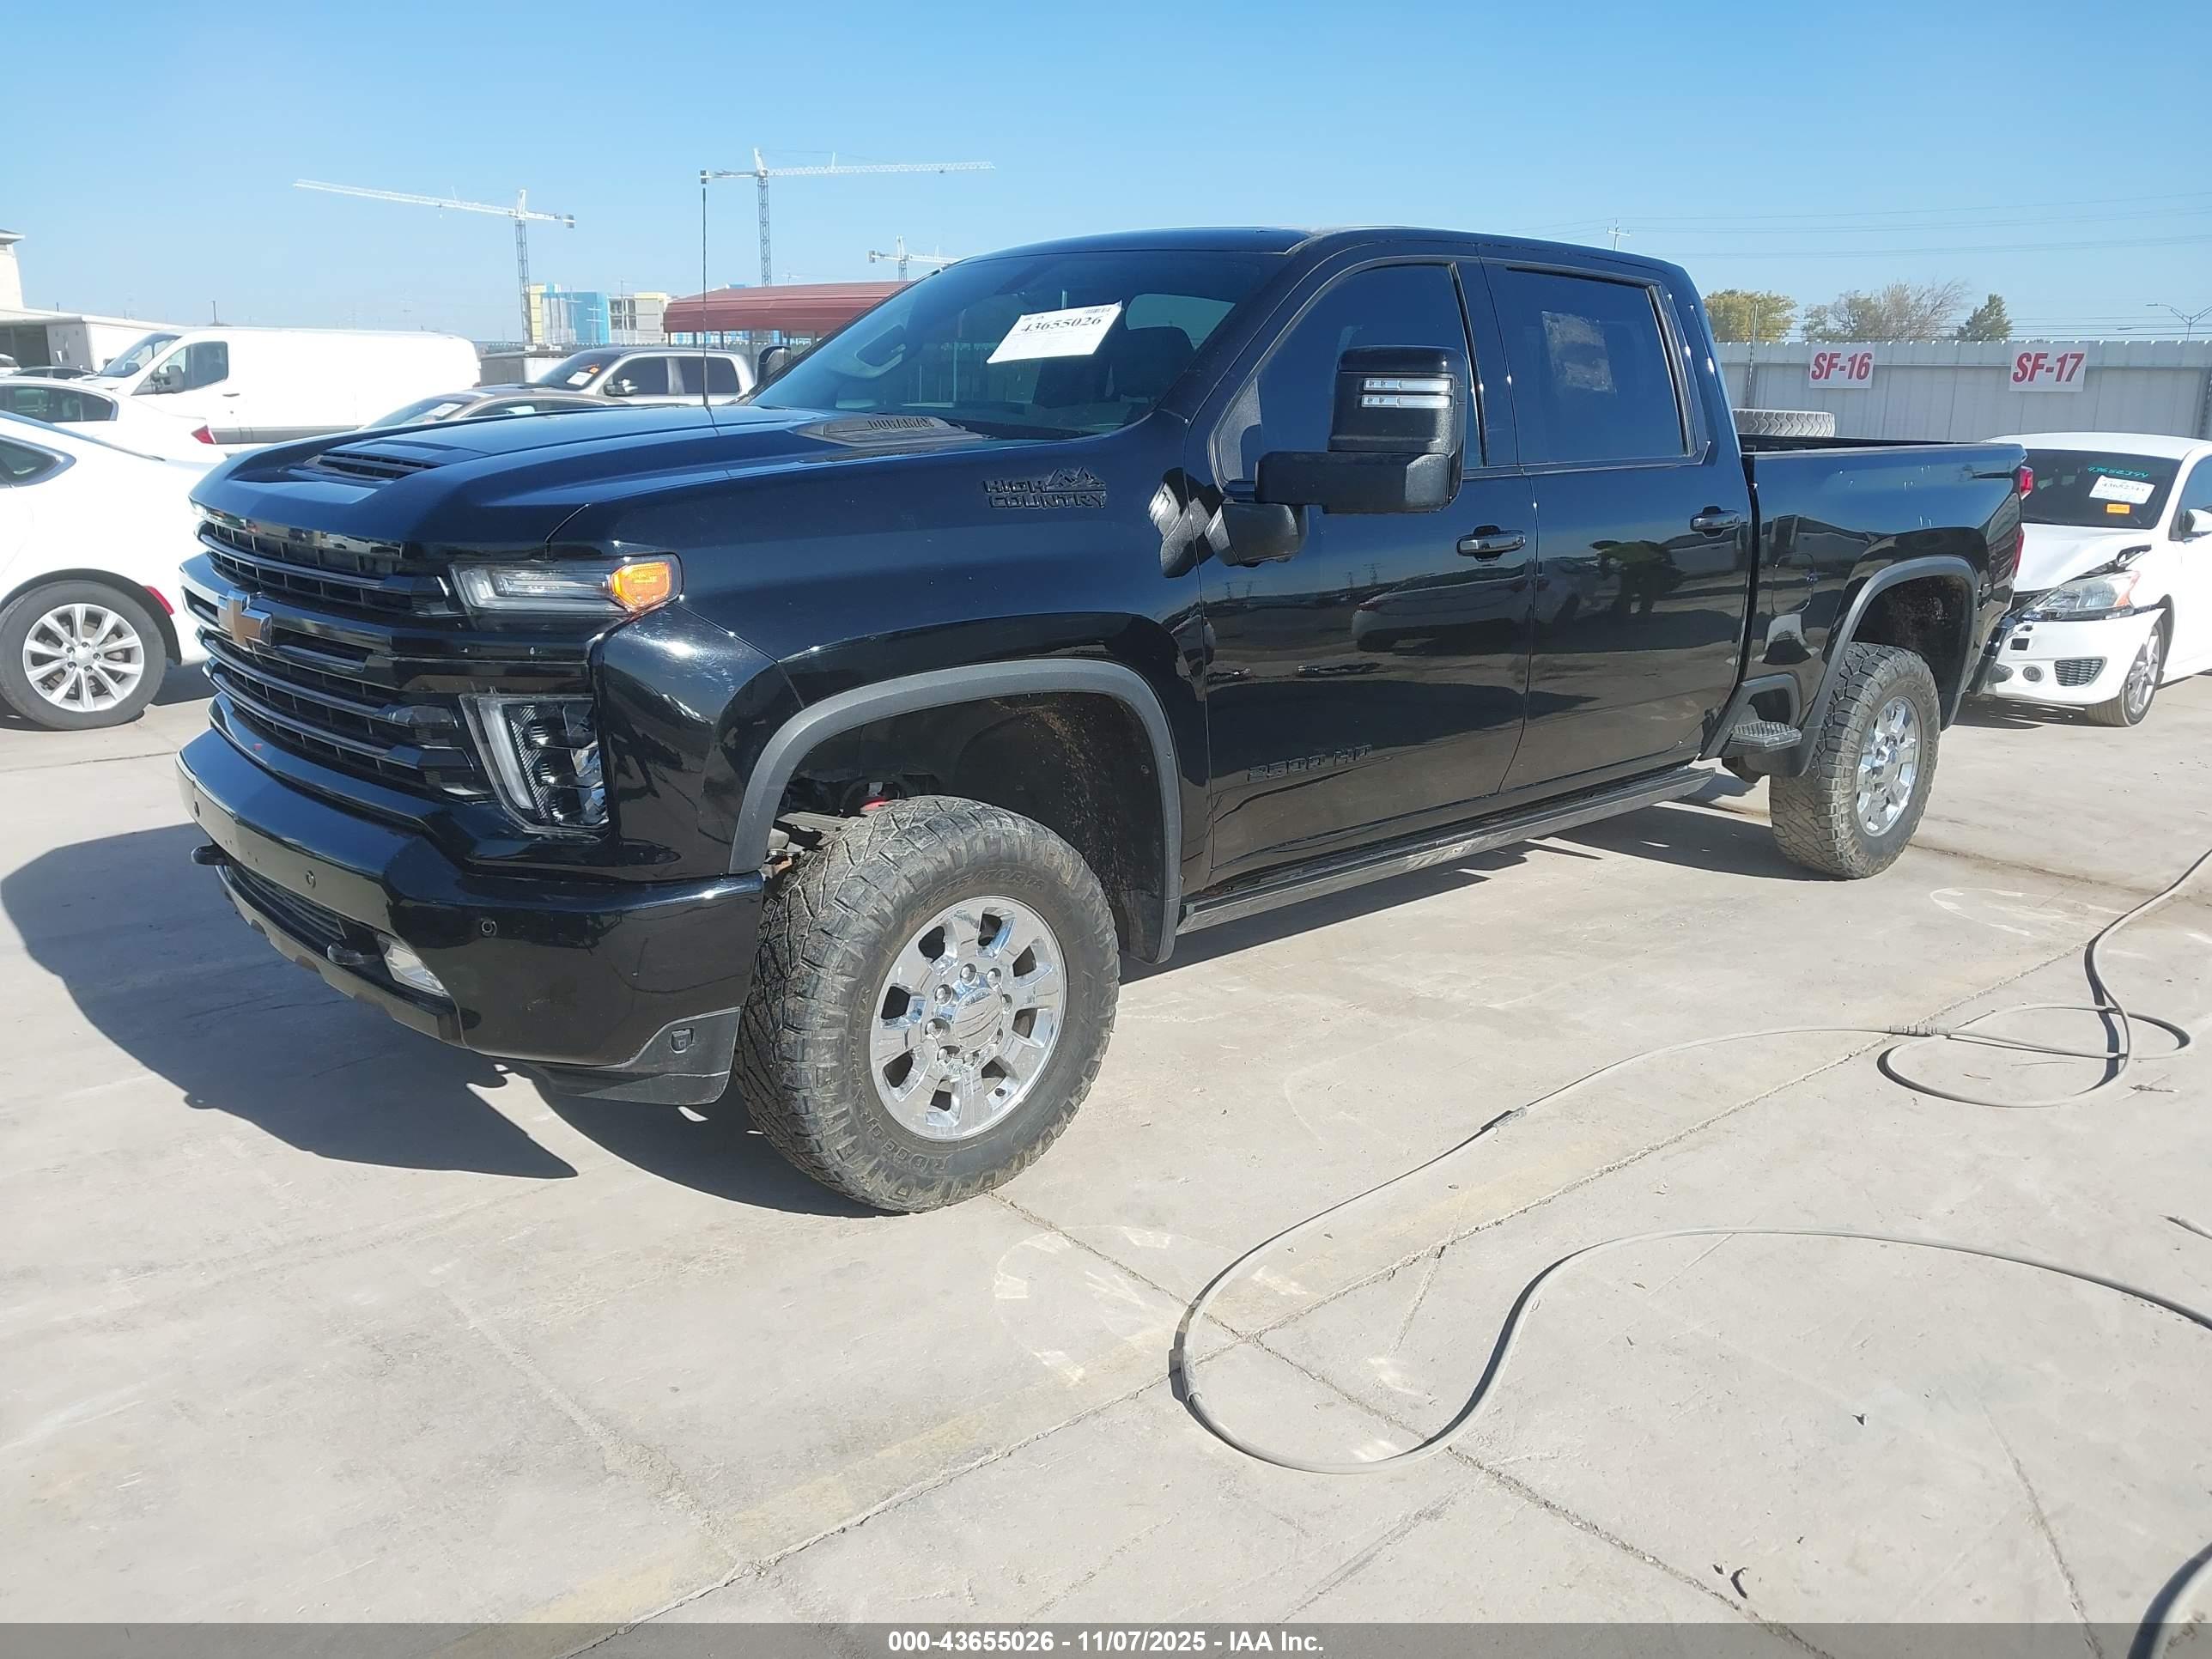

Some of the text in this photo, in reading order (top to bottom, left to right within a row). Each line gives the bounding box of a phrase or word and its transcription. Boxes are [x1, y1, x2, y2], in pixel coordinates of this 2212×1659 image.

[1020, 314, 1103, 332] 43655026
[1810, 351, 1873, 380] SF-16
[2011, 351, 2085, 383] SF-17
[982, 480, 1047, 494] HIGH
[988, 494, 1106, 509] COUNTRY
